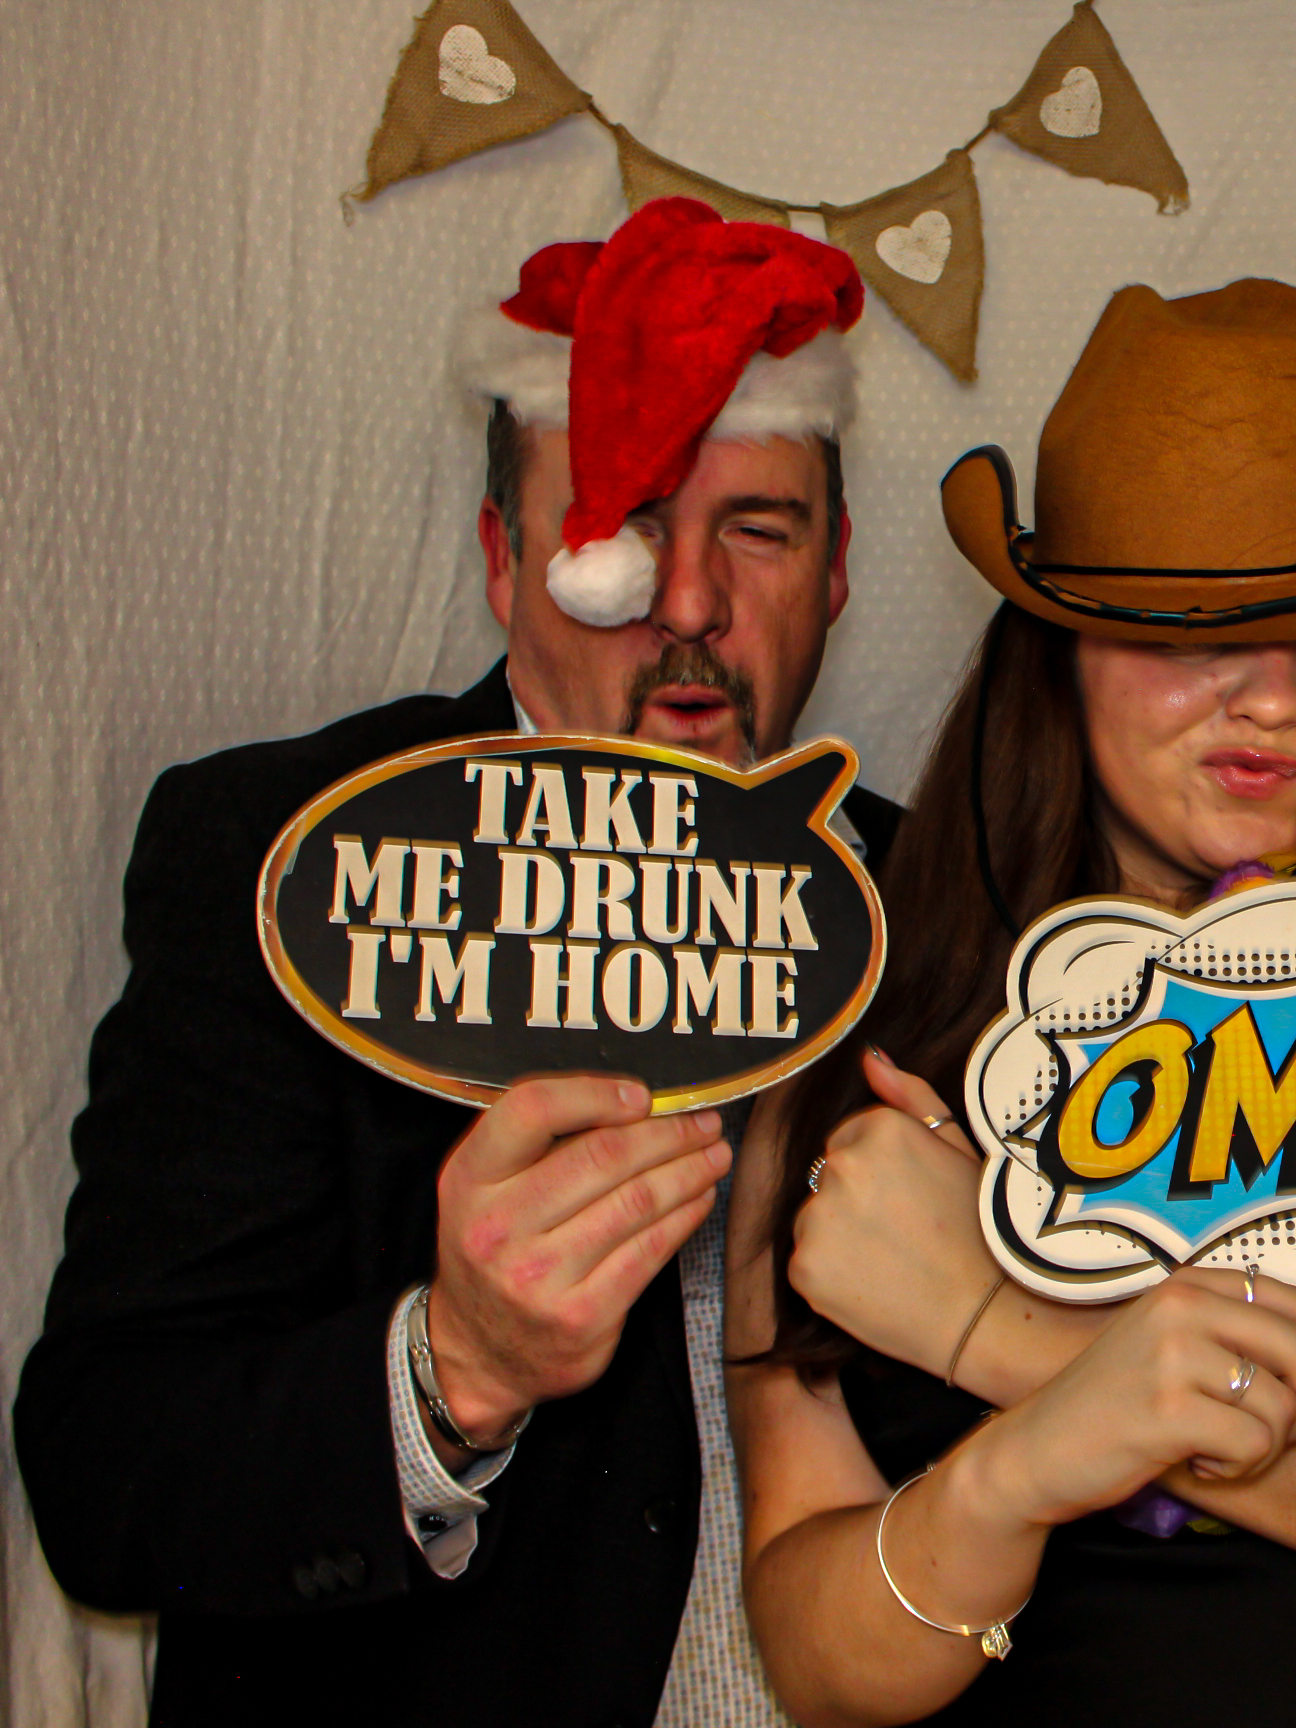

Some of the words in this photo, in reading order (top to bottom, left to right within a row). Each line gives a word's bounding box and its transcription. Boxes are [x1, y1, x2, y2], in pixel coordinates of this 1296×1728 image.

[465, 761, 698, 856] TAKE
[329, 837, 464, 930] ME
[495, 849, 819, 950] DRUNK
[342, 928, 496, 1025] I'M
[526, 941, 800, 1038] HOME
